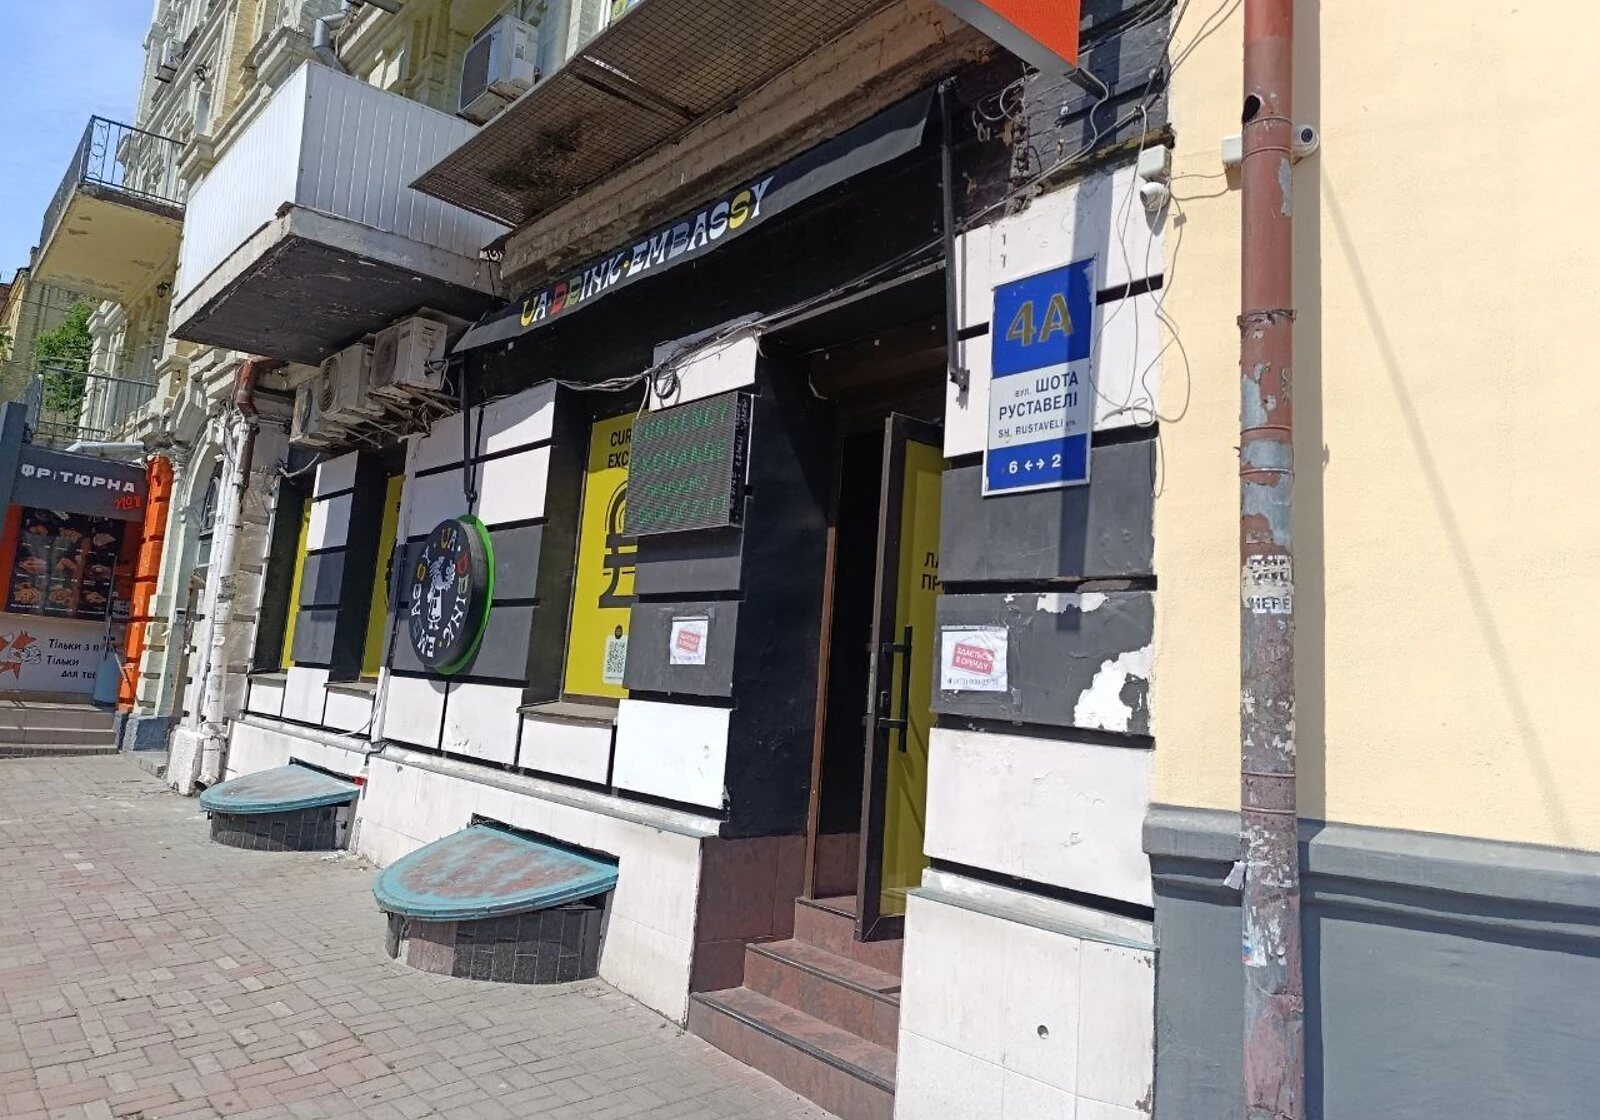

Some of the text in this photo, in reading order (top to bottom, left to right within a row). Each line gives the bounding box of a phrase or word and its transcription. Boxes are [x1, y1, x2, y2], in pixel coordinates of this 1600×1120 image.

[626, 176, 774, 277] EMBASSY
[1006, 292, 1073, 346] 4А
[1035, 370, 1079, 393] ШОТА
[999, 391, 1077, 420] РУСТАВЕЛІ
[1015, 418, 1063, 435] RUSTAVELI
[1009, 454, 1061, 474] 6 2
[21, 463, 135, 493] ФРІТЮРНА
[440, 528, 457, 551] UA
